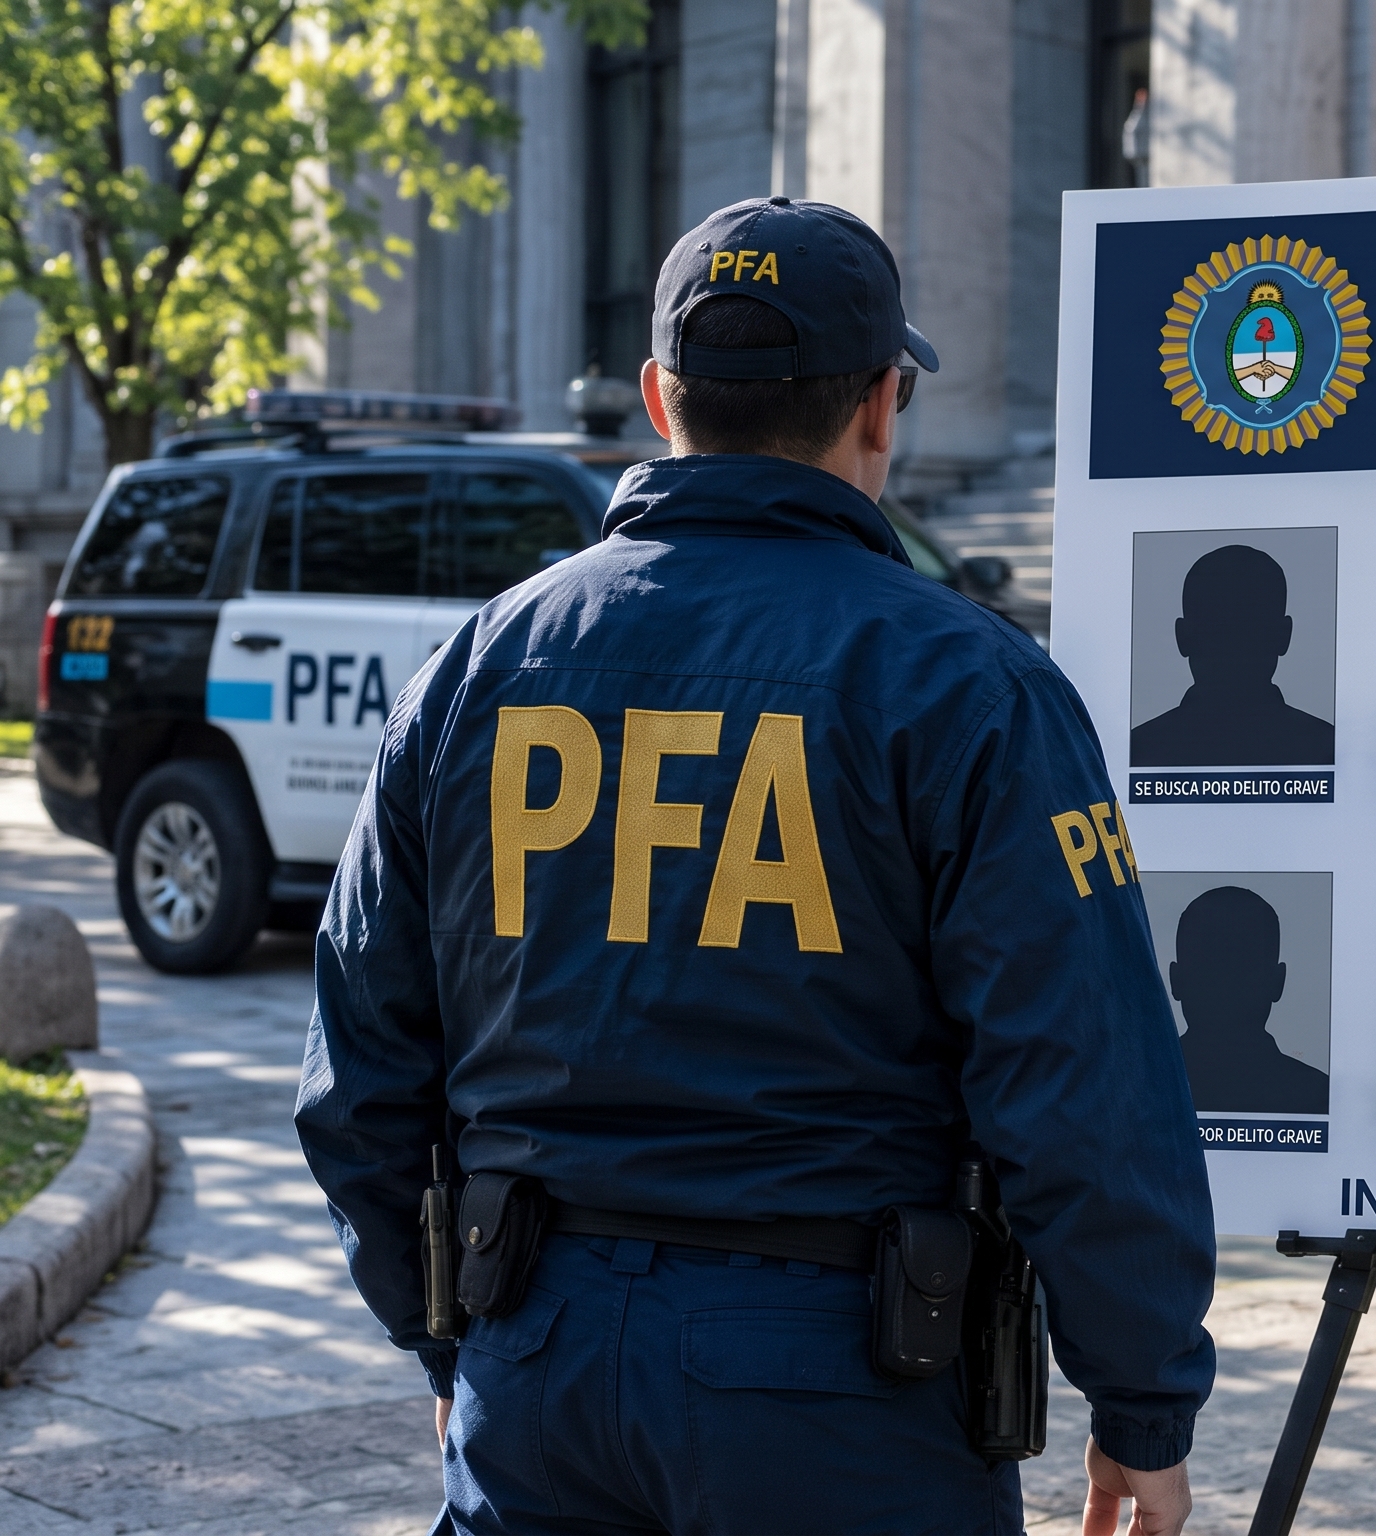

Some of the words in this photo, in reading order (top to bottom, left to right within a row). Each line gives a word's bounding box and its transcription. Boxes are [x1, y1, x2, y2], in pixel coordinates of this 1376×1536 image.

[709, 250, 779, 285] PFA
[287, 654, 390, 725] PFA
[1135, 781, 1152, 796] SE
[1155, 780, 1200, 796] BUSCA
[1202, 780, 1230, 796] POR
[1233, 780, 1281, 795] DELITO
[1283, 779, 1328, 795] GRAVE
[490, 705, 843, 953] PFA
[1050, 799, 1140, 898] PFA
[1227, 1127, 1274, 1143] DELITO
[1277, 1128, 1322, 1144] GRAVE
